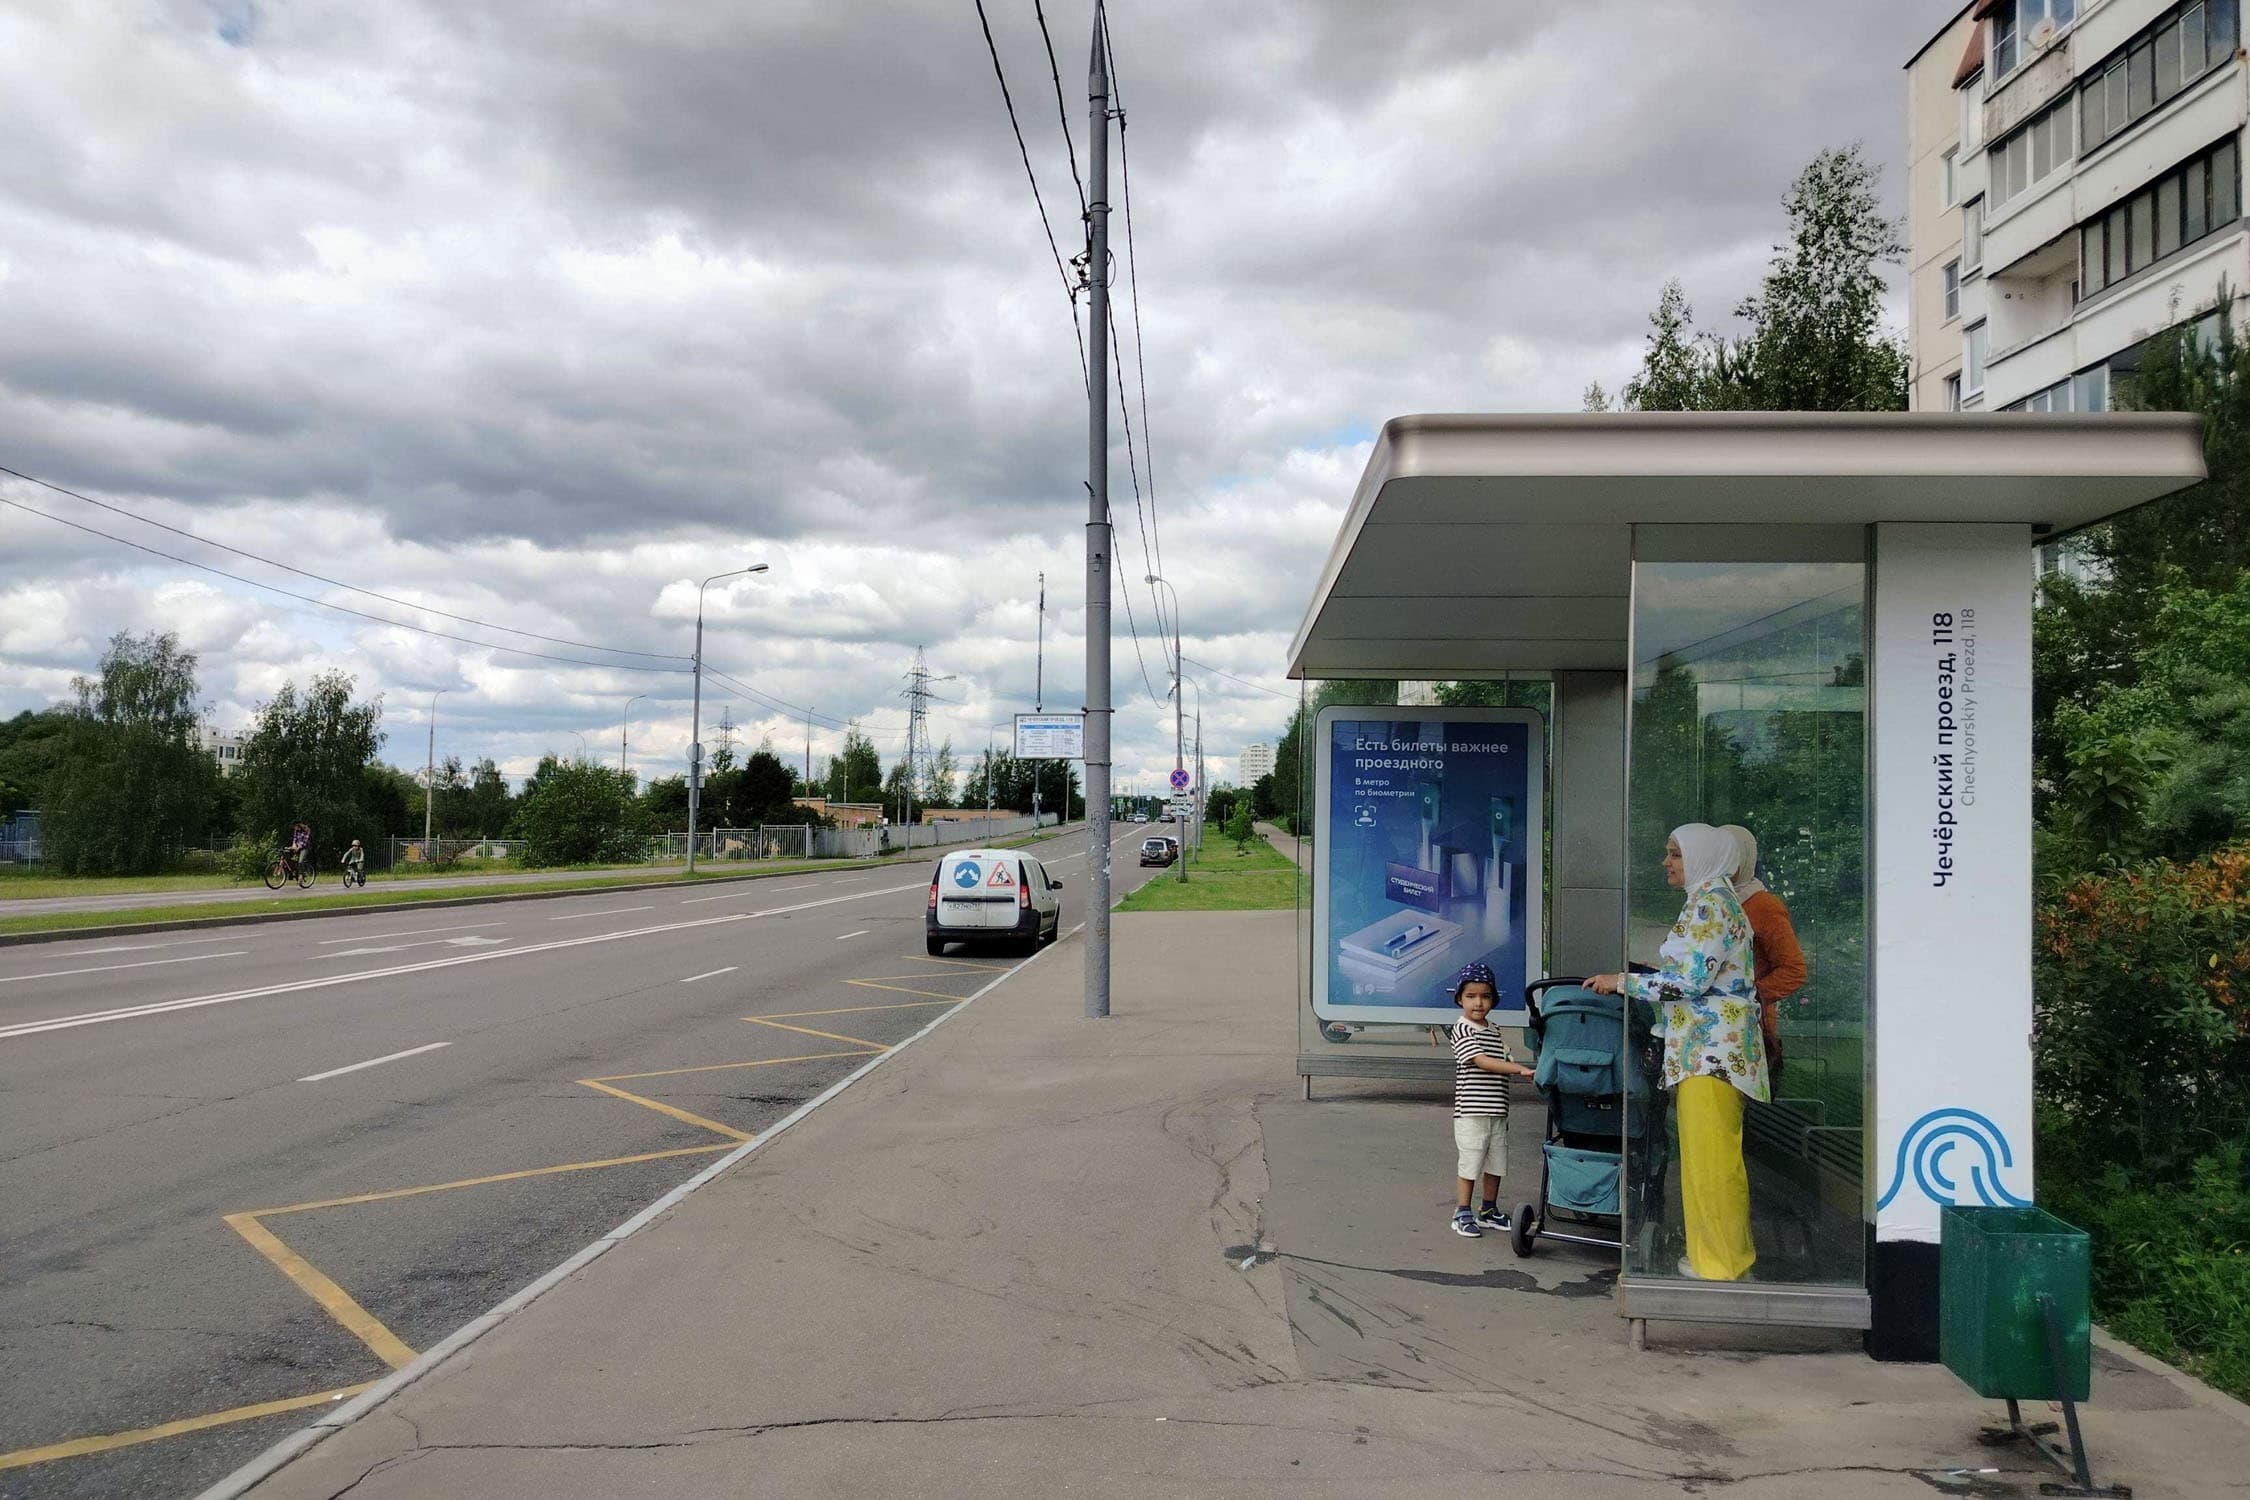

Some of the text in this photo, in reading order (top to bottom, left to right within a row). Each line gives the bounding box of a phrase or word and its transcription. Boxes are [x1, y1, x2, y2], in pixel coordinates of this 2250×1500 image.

[1960, 608, 1978, 807] Chechyorskiy Proezd, 118
[1355, 738, 1509, 753] Есть билеты важнее
[1932, 612, 1958, 888] Чечёрский проезд, 118
[1355, 758, 1444, 770] проездного
[1355, 777, 1390, 787] В метро
[1355, 788, 1415, 798] по биометрии
